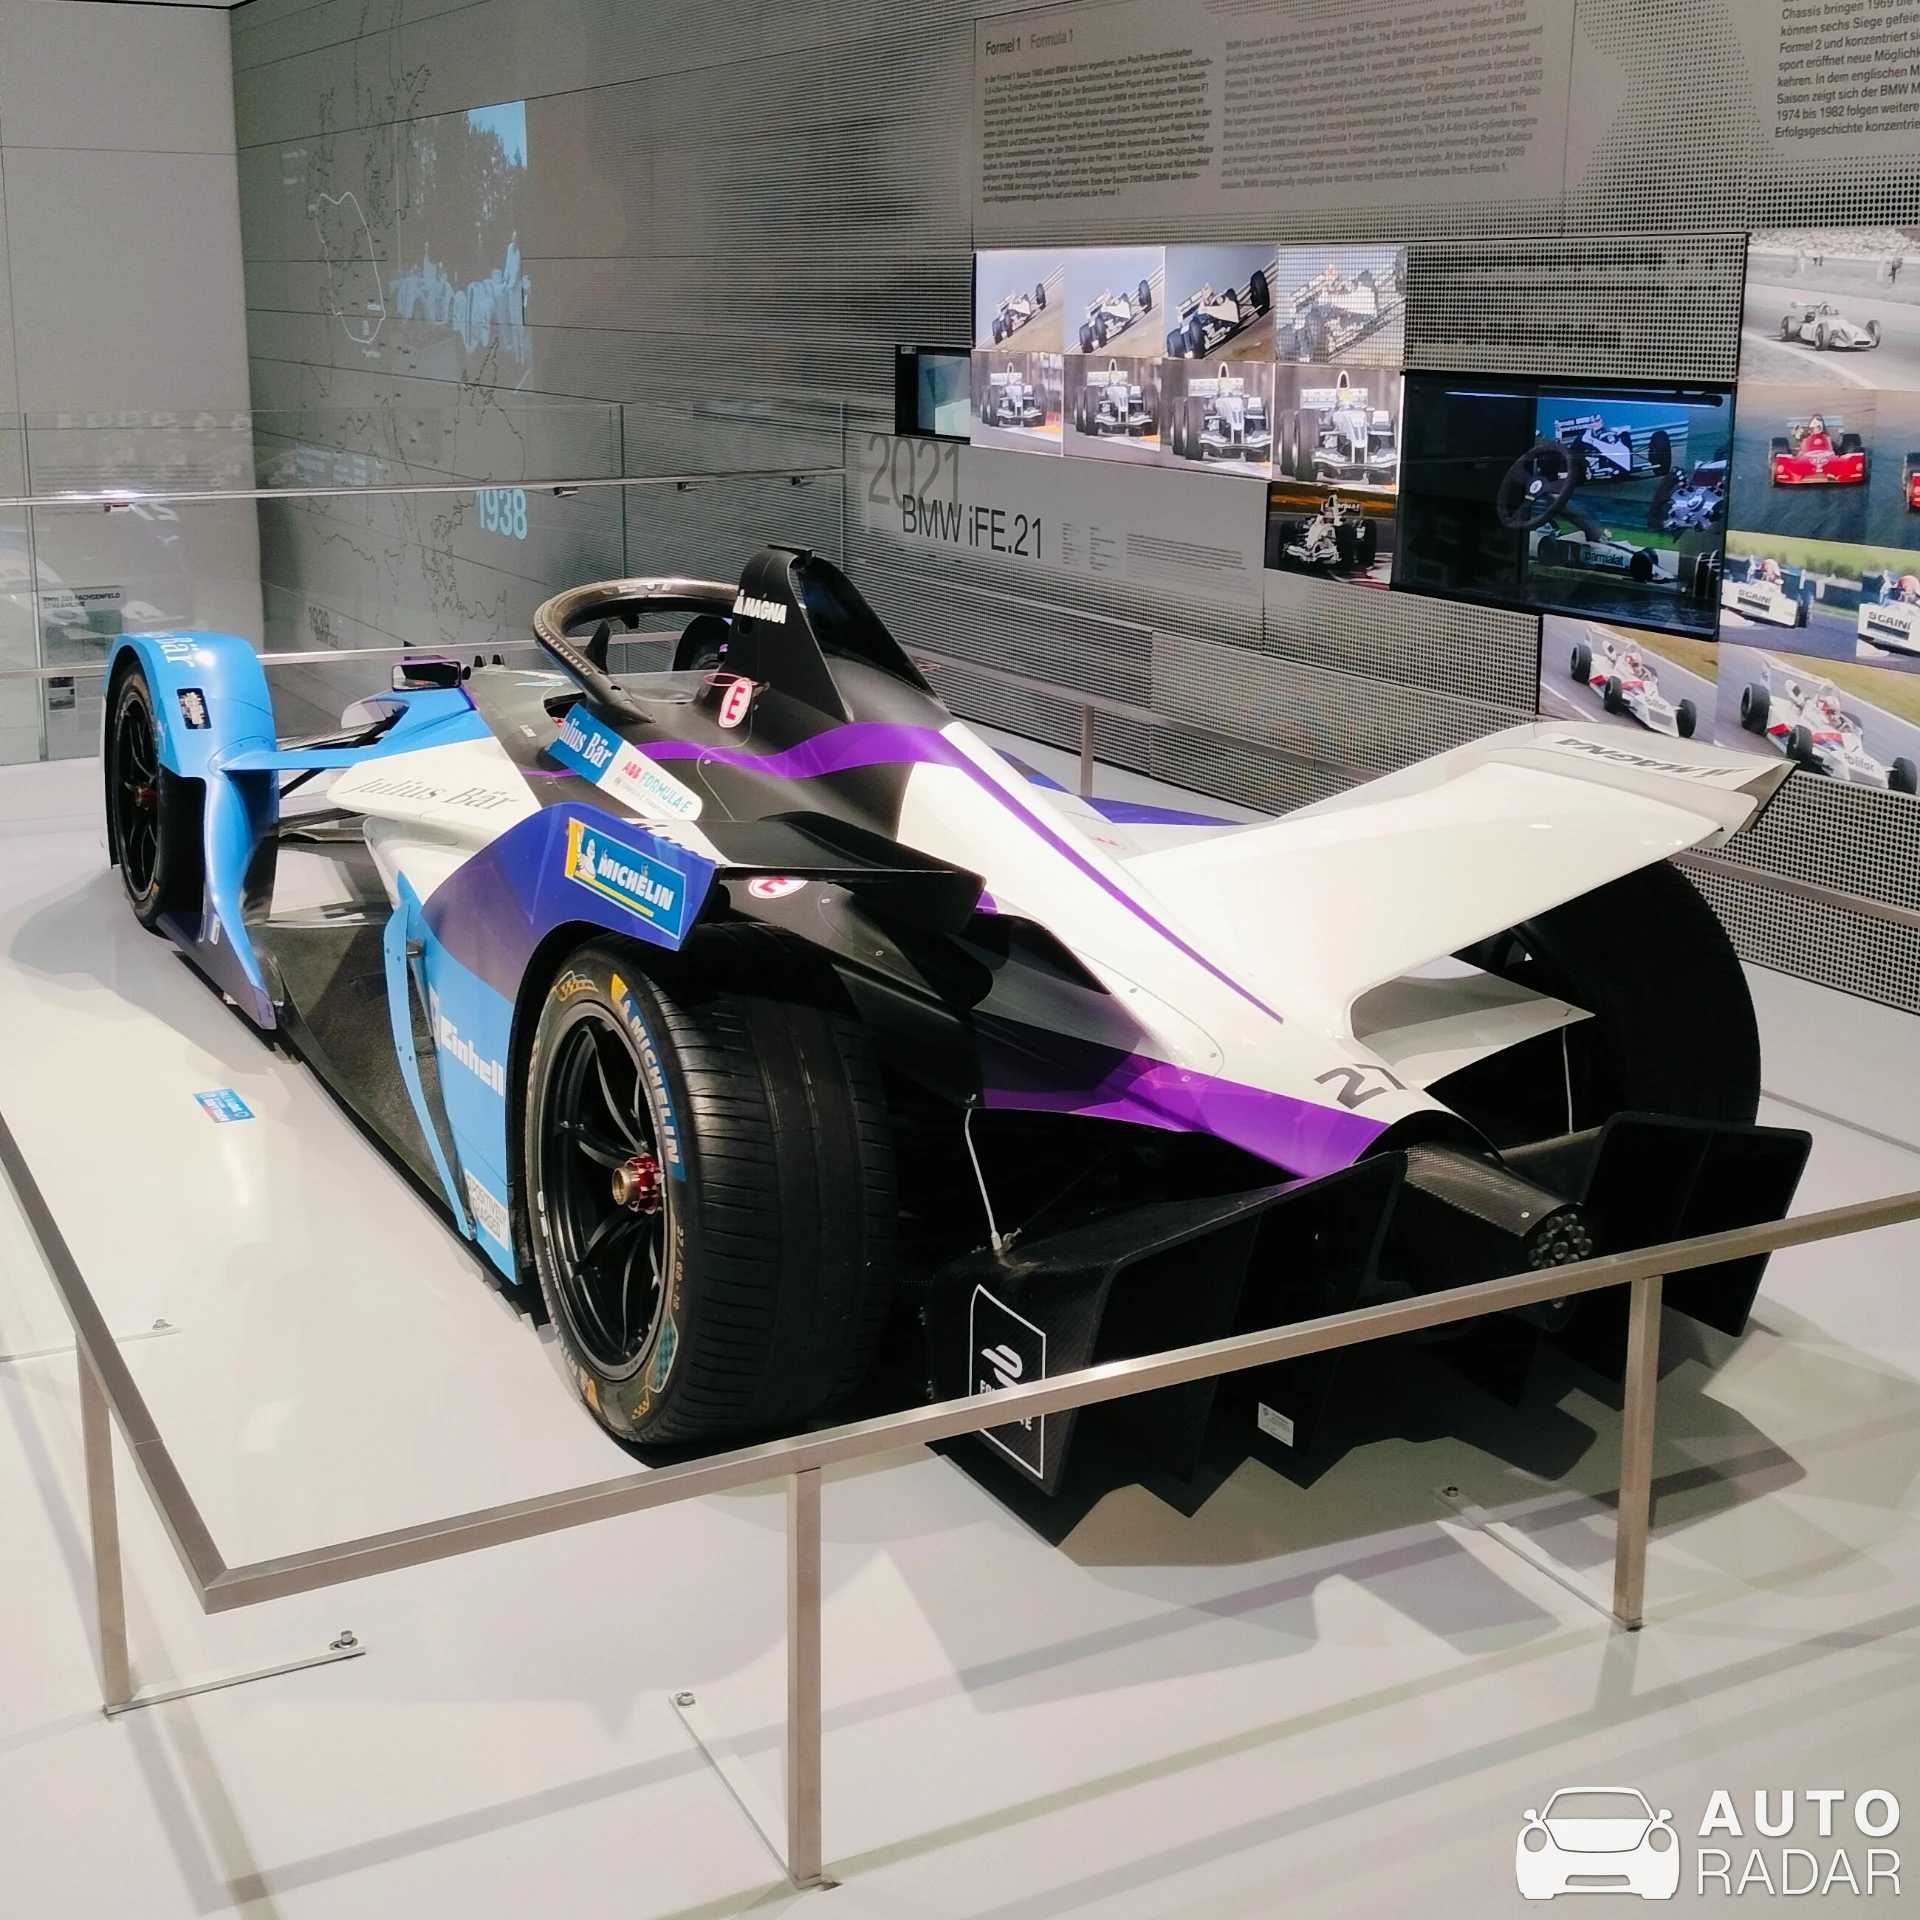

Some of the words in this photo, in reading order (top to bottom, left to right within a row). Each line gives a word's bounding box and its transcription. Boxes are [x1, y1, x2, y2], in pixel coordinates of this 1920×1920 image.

[1782, 5, 1821, 19] Chassis
[1824, 2, 1864, 15] bringen
[1030, 31, 1067, 49] Formula
[1781, 25, 1818, 36] können
[1820, 20, 1850, 32] sechs
[1853, 16, 1882, 29] Siege
[986, 38, 1014, 56] Formel
[1780, 40, 1813, 53] Formel
[1815, 39, 1821, 50] 2
[1824, 37, 1843, 49] und
[1845, 31, 1907, 47] konzentriert
[1778, 76, 1813, 87] kehren.
[1816, 73, 1825, 84] In
[1827, 71, 1849, 83] dem
[1852, 67, 1908, 82] englischen
[1779, 59, 1804, 73] sport
[1806, 55, 1845, 69] eröffnet
[1847, 53, 1872, 64] neue
[1777, 91, 1810, 104] Saison
[1812, 89, 1836, 103] zeigt
[1838, 87, 1859, 99] sich
[1861, 86, 1878, 98] der
[1881, 83, 1909, 96] BMW
[1777, 109, 1800, 121] 1974
[1802, 108, 1817, 119] bis
[1820, 105, 1845, 118] 1982
[1847, 104, 1879, 118] folgen
[1881, 101, 1919, 113] weitere
[1775, 122, 1863, 139] Erfolgsgeschichte
[868, 434, 960, 518] 2021
[476, 488, 528, 540] 1938
[902, 495, 962, 543] BMW
[968, 505, 1042, 560] iFE.21
[742, 596, 788, 625] MAGNA
[725, 686, 747, 720] E
[558, 718, 588, 752] ulius
[582, 732, 613, 768] Bär
[1555, 738, 1708, 774] MAGNA
[621, 761, 642, 780] ABB
[338, 778, 447, 800] Julius
[440, 787, 518, 810] Bär
[597, 857, 675, 912] MICHELIN
[441, 1015, 504, 1097] Einhell
[629, 1015, 680, 1164] MICHELIN
[1313, 1063, 1409, 1110] 21
